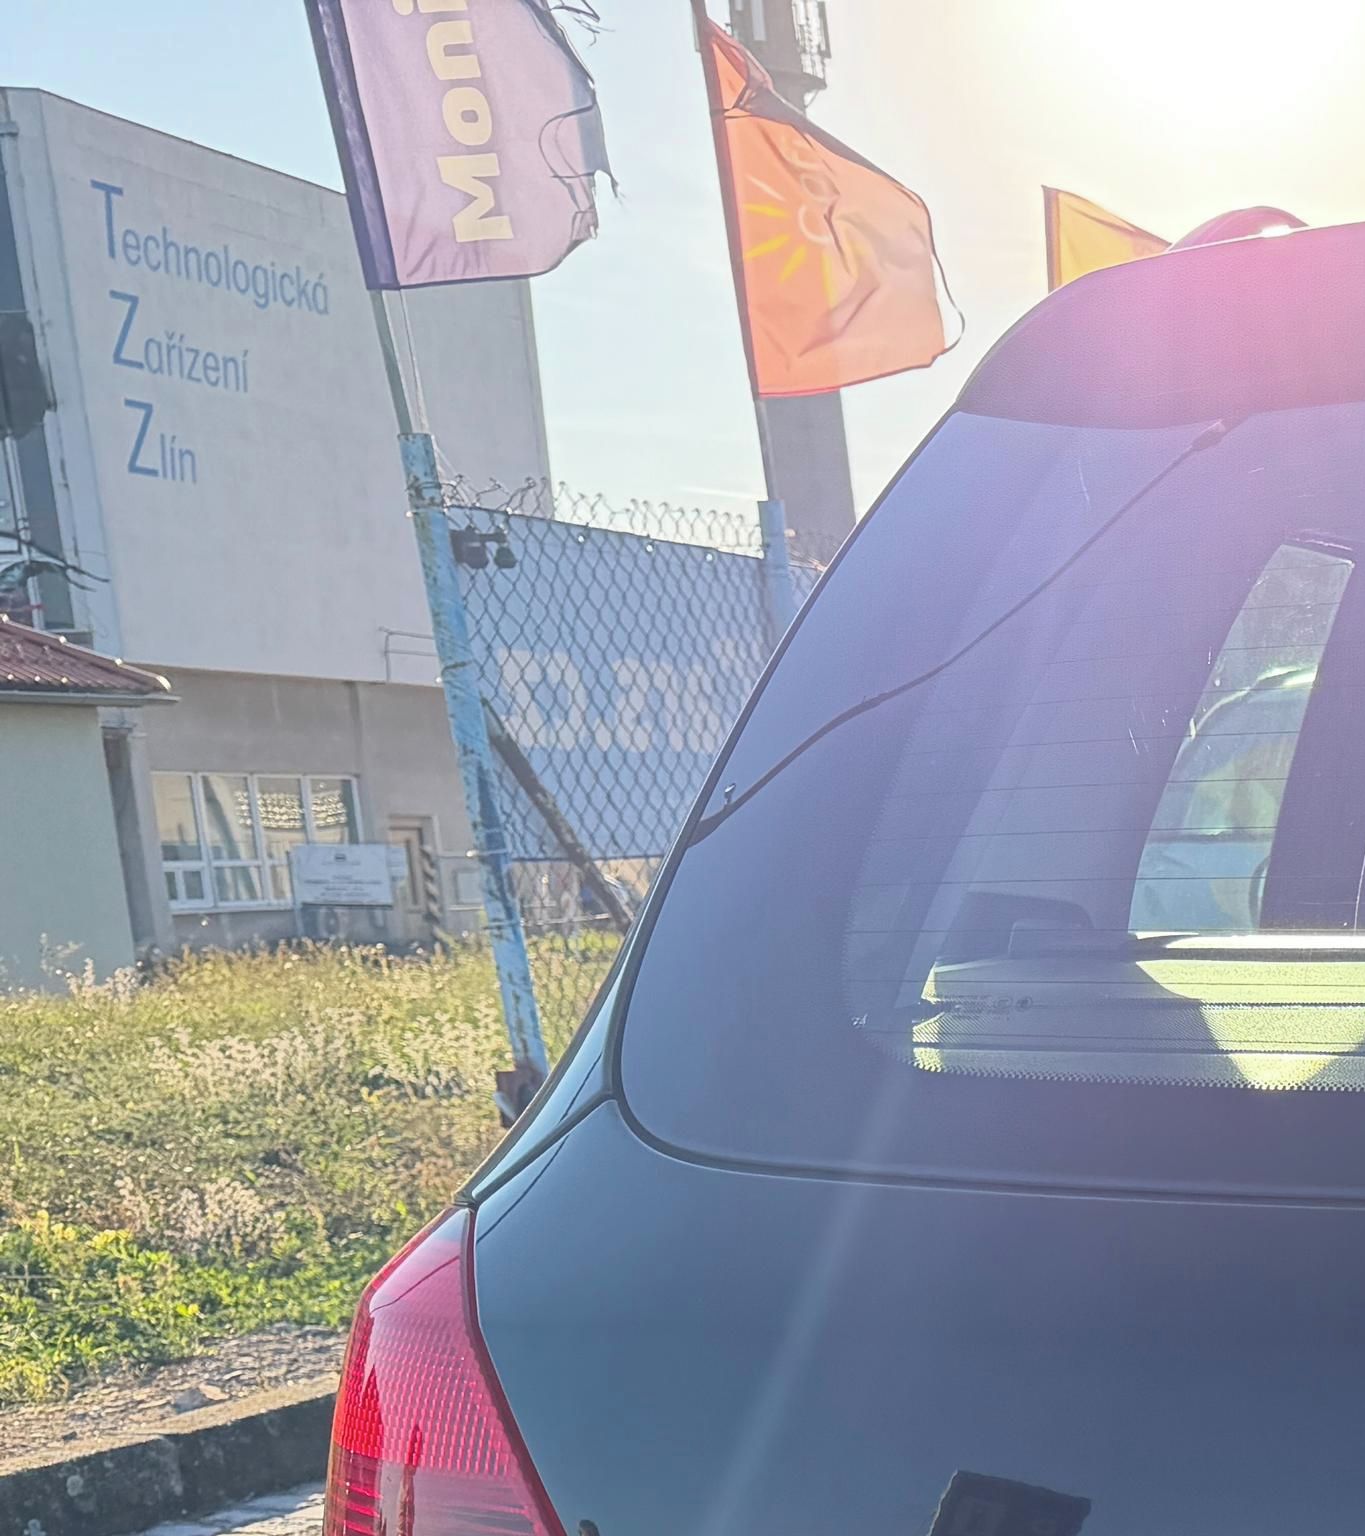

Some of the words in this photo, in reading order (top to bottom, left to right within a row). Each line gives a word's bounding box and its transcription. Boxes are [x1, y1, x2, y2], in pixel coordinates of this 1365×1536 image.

[90, 179, 330, 316] Technologická
[109, 289, 249, 393] Zařízení
[124, 399, 198, 484] Zlín
